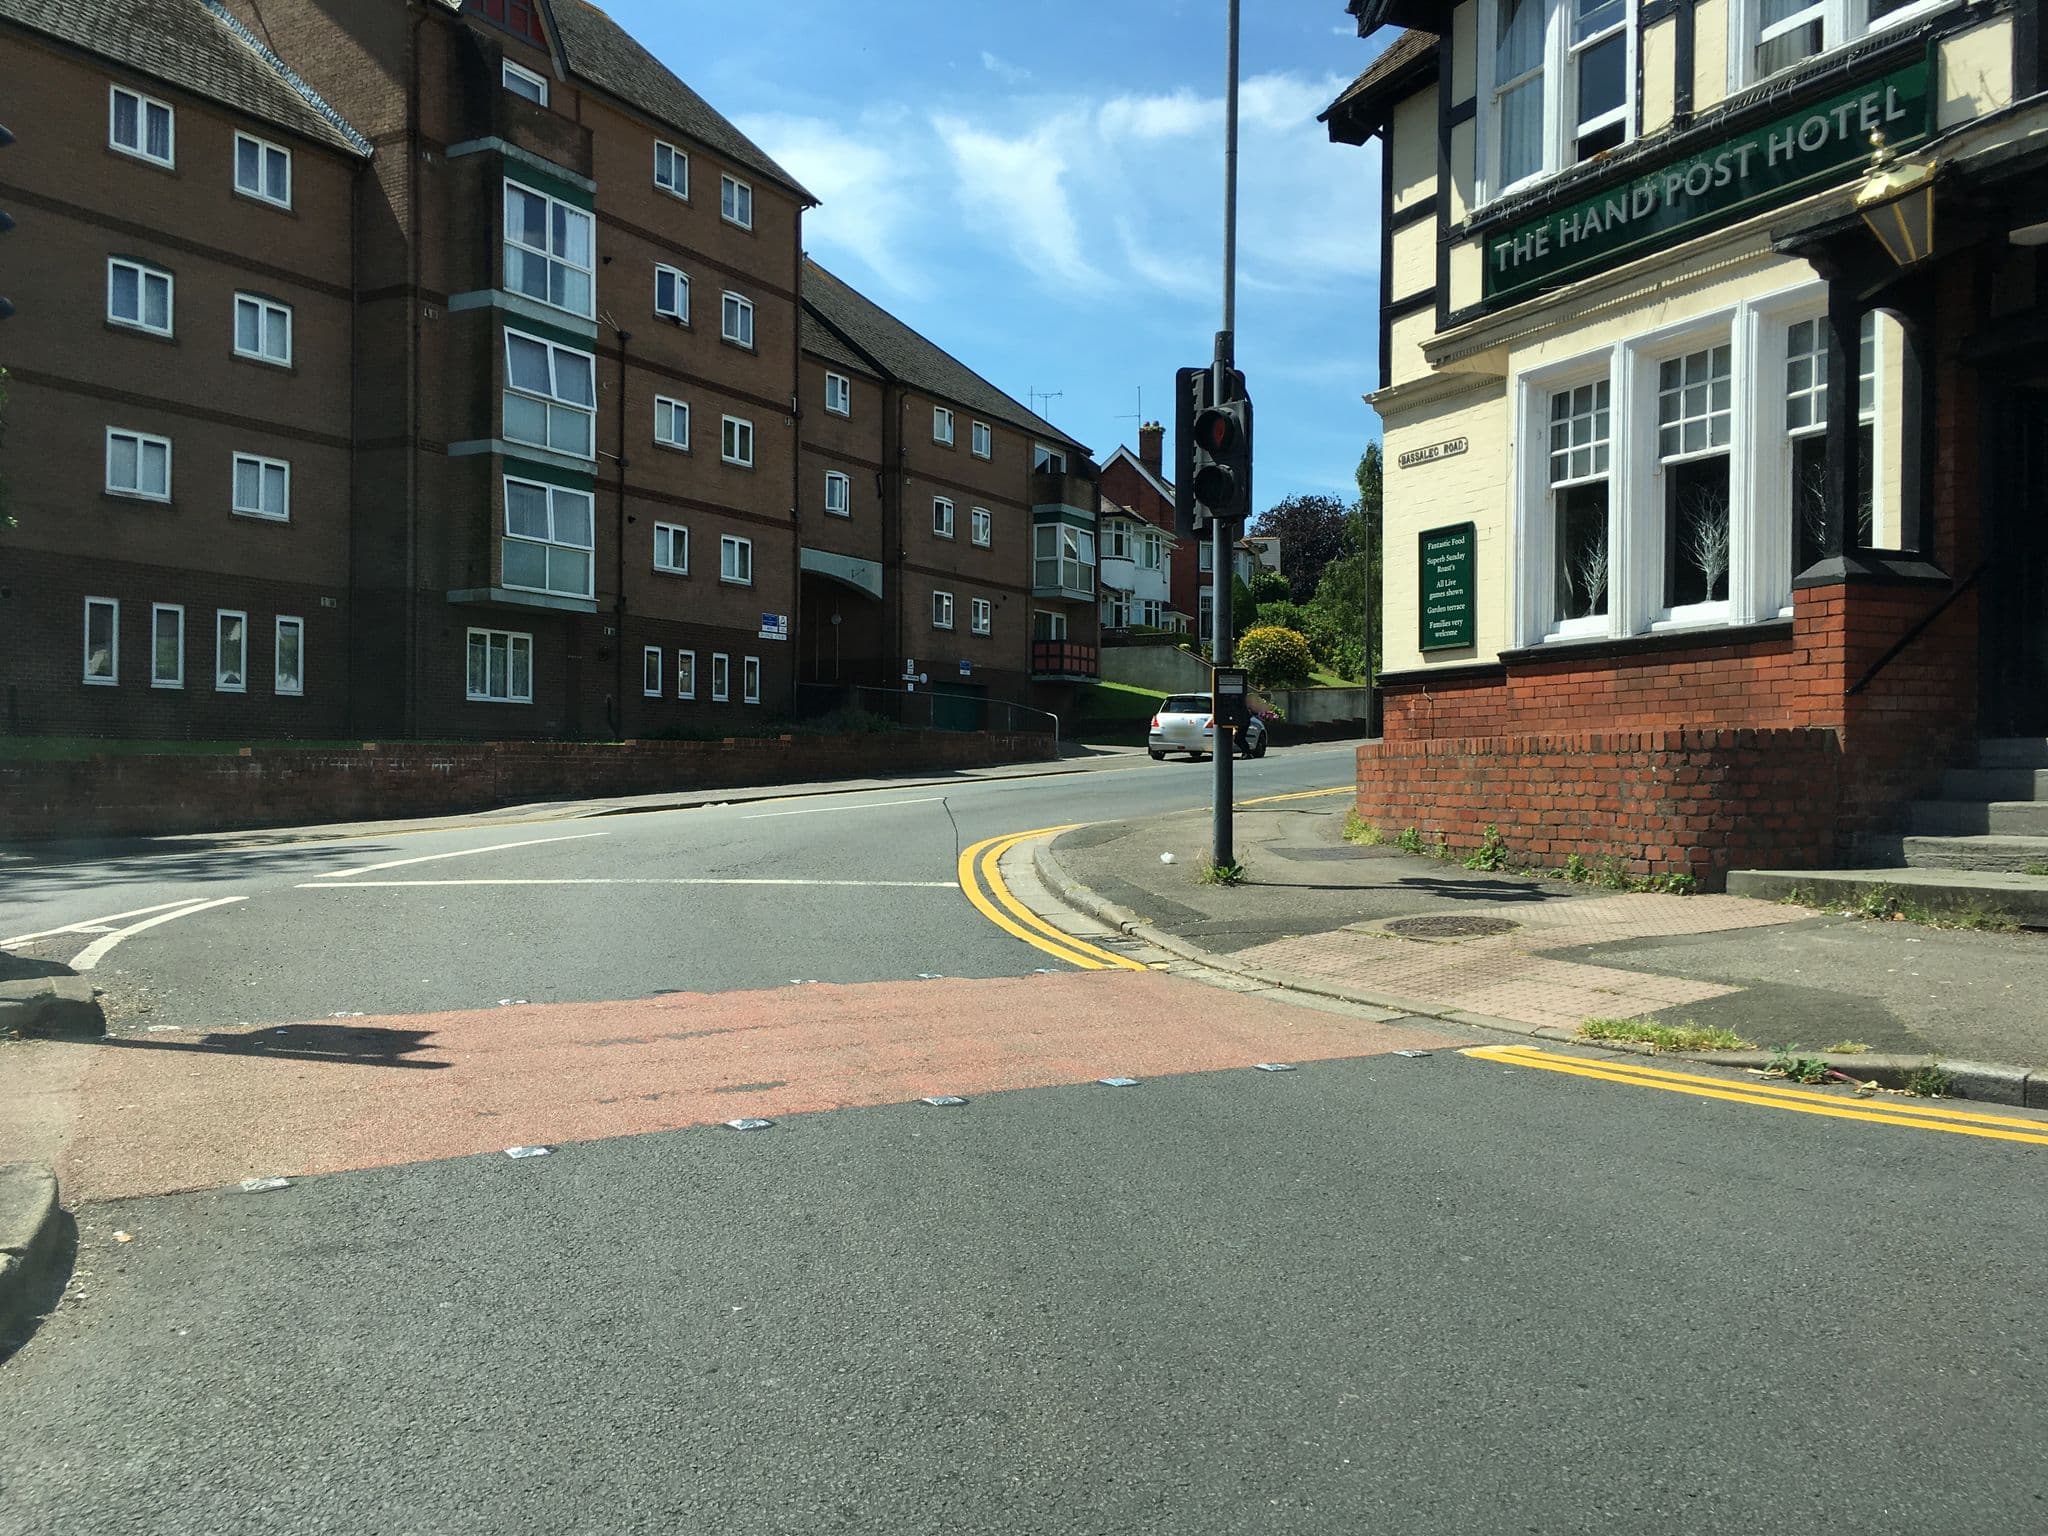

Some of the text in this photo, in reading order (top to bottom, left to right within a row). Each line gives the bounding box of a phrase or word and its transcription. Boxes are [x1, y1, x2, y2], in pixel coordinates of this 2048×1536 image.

[1494, 85, 1906, 272] THE HAND POST HOTEL
[1443, 440, 1464, 454] ROAD
[1427, 535, 1465, 550] Fantastic Food
[1427, 552, 1466, 566] Superb Sunday
[1436, 578, 1457, 588] All Live
[1429, 588, 1464, 600] games shown
[1427, 603, 1466, 613] Garden terrace
[1429, 619, 1464, 628] Families very
